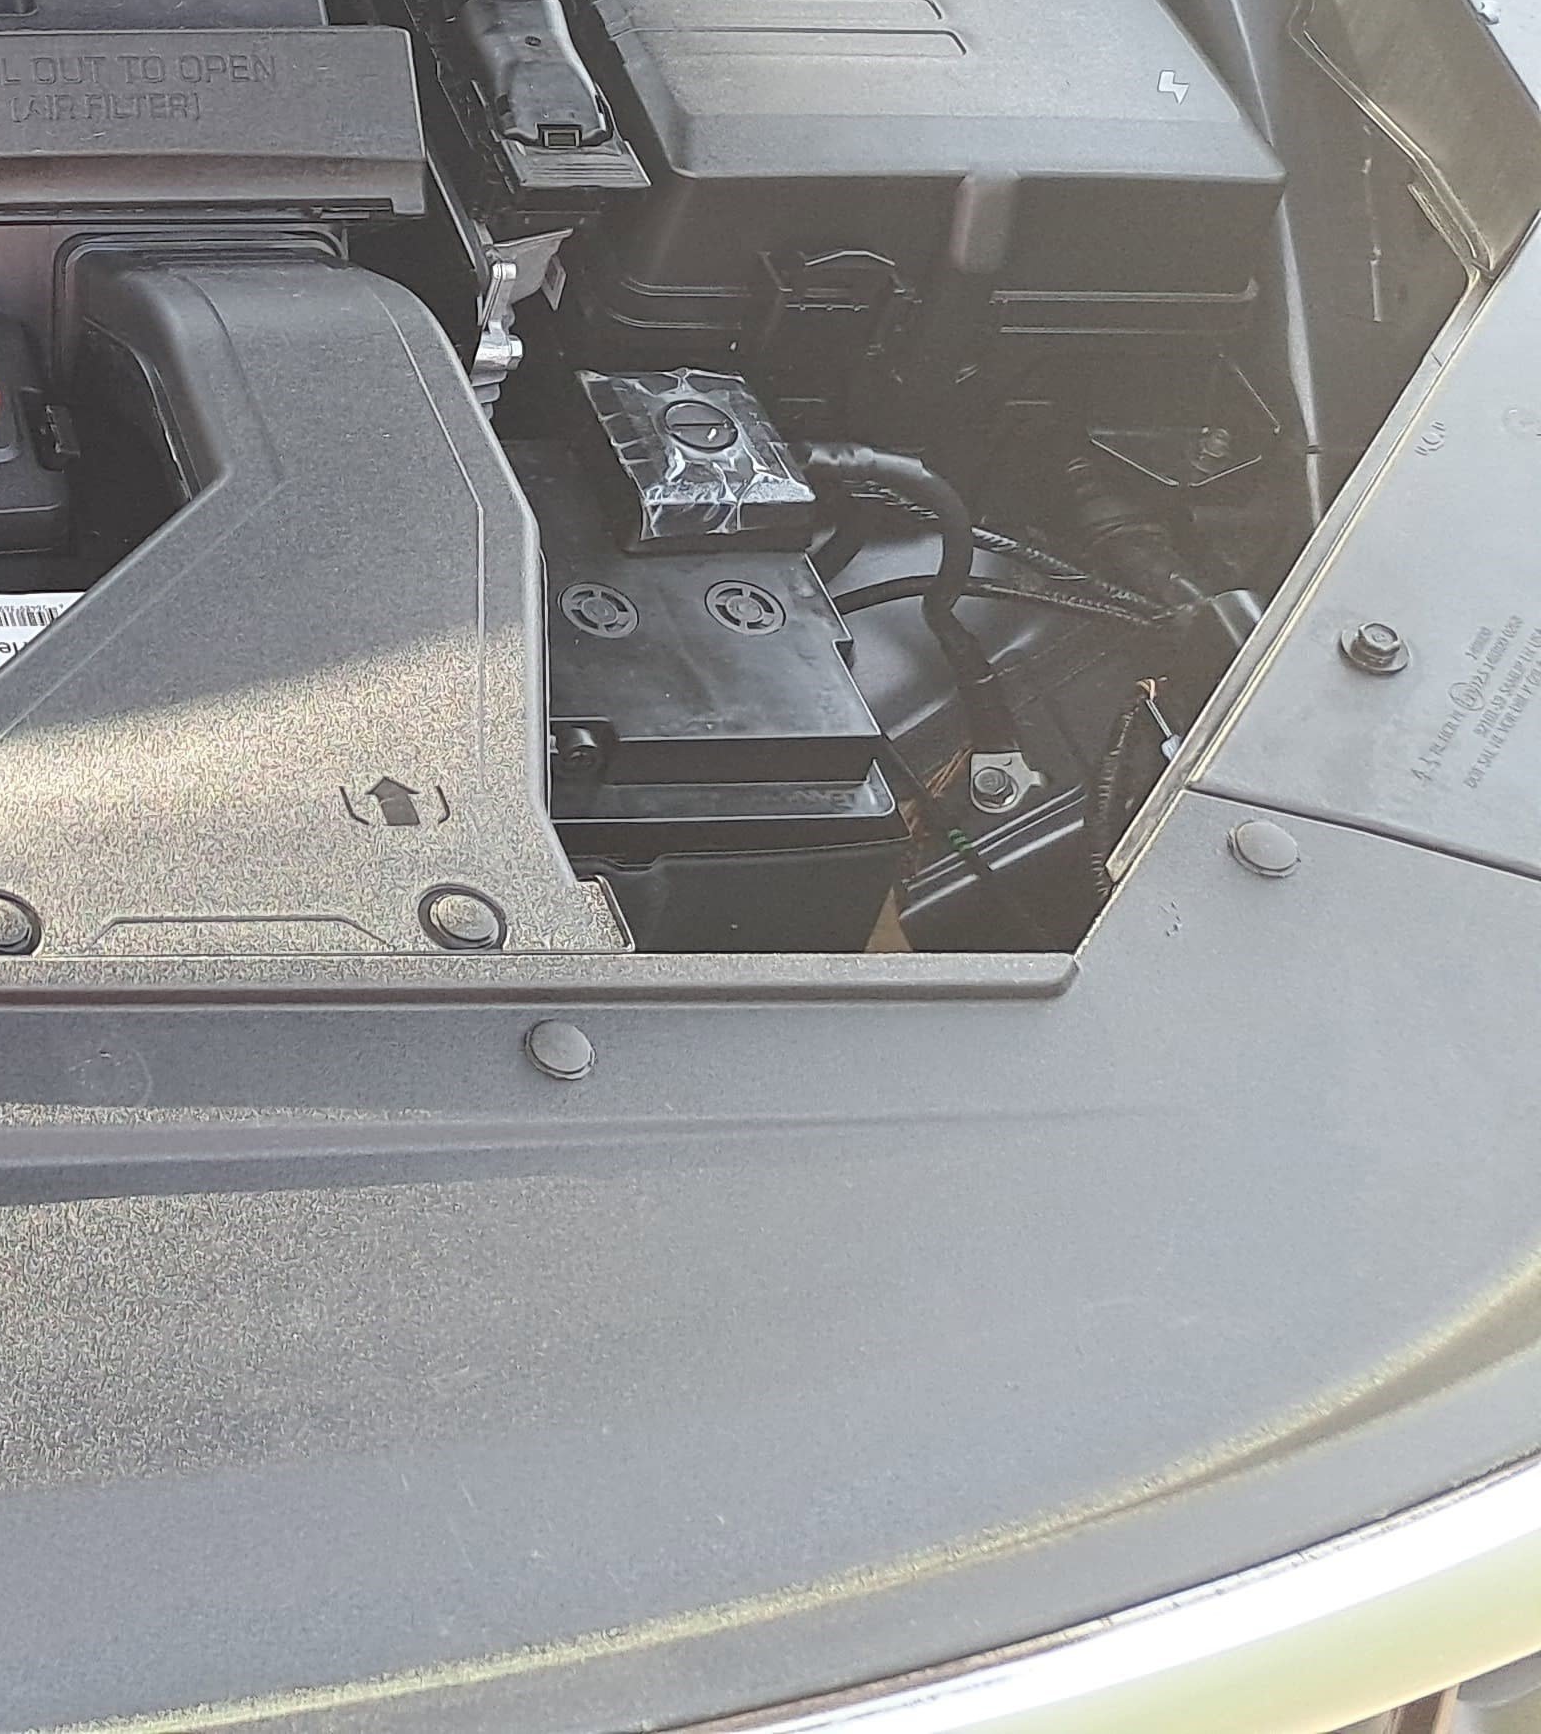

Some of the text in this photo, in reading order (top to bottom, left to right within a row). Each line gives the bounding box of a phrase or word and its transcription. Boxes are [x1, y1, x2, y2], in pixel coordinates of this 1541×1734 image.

[32, 55, 107, 85] OUT
[117, 55, 166, 84] TO
[178, 54, 278, 84] OPEN
